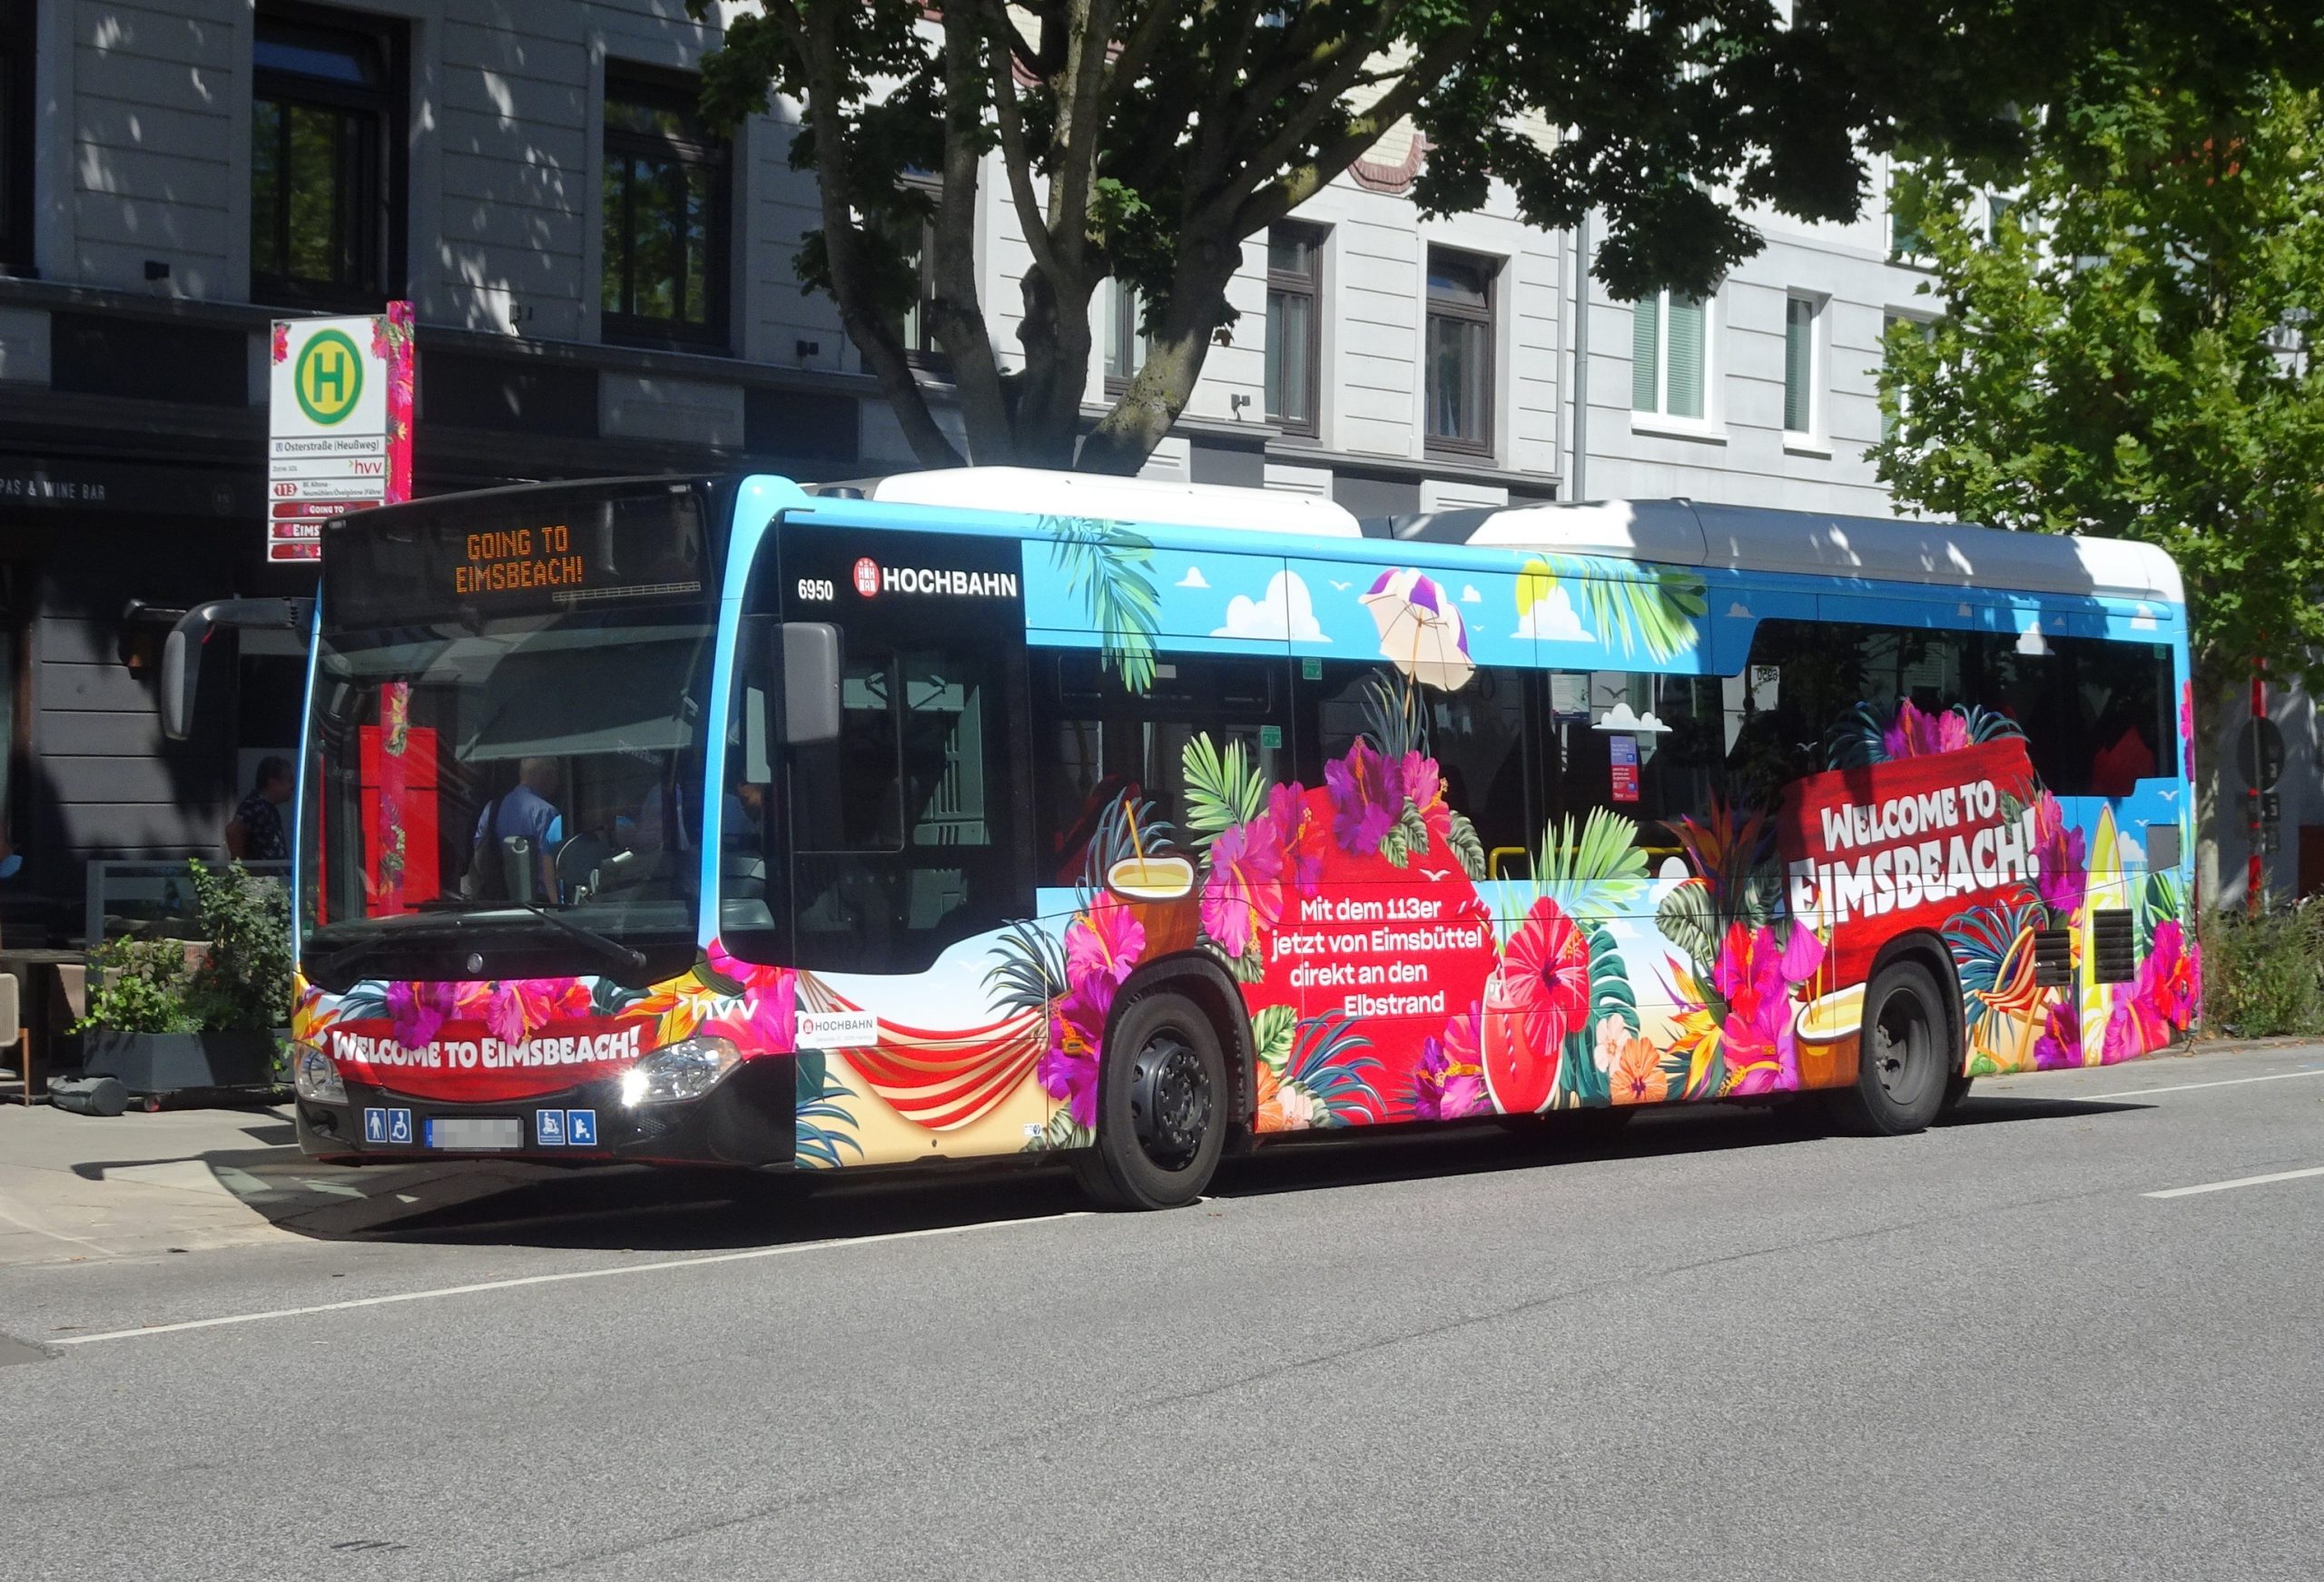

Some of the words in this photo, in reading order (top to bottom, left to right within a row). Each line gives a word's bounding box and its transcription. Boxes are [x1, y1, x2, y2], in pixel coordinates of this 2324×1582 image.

[313, 351, 344, 403] H
[284, 440, 332, 451] Osterstraße
[334, 439, 379, 452] (Heußweg)
[355, 459, 382, 475] hvv
[28, 480, 36, 496] &
[44, 481, 74, 498] WINE
[83, 483, 104, 500] BAR
[277, 485, 295, 496] 113
[309, 505, 333, 515] GOING
[333, 505, 344, 514] TO
[467, 529, 531, 560] GOING
[541, 526, 568, 553] TO
[456, 555, 583, 593] EIMSBEACH!
[882, 566, 1018, 597] HOCHBAHN
[798, 579, 833, 600] 6950
[1820, 787, 1957, 851] WELCOME
[1959, 779, 1996, 821] TO
[1788, 805, 2041, 930] EIMSBEACH!
[1301, 896, 1333, 921] Mit
[1335, 898, 1384, 920] dem
[1386, 898, 1443, 919] 113er
[1271, 929, 1325, 963] jetzt
[1328, 933, 1367, 953] von
[1371, 926, 1482, 952] Eimsbüttel
[1290, 961, 1355, 988] direkt
[1358, 967, 1385, 984] an
[1388, 960, 1428, 983] den
[691, 995, 759, 1020] hvv
[1344, 989, 1445, 1017] Elbstrand
[815, 1018, 873, 1031] HOCHBAHN
[332, 1030, 441, 1068] WELCOME
[445, 1041, 478, 1068] TO
[481, 1024, 641, 1068] EIMSBEACH!
